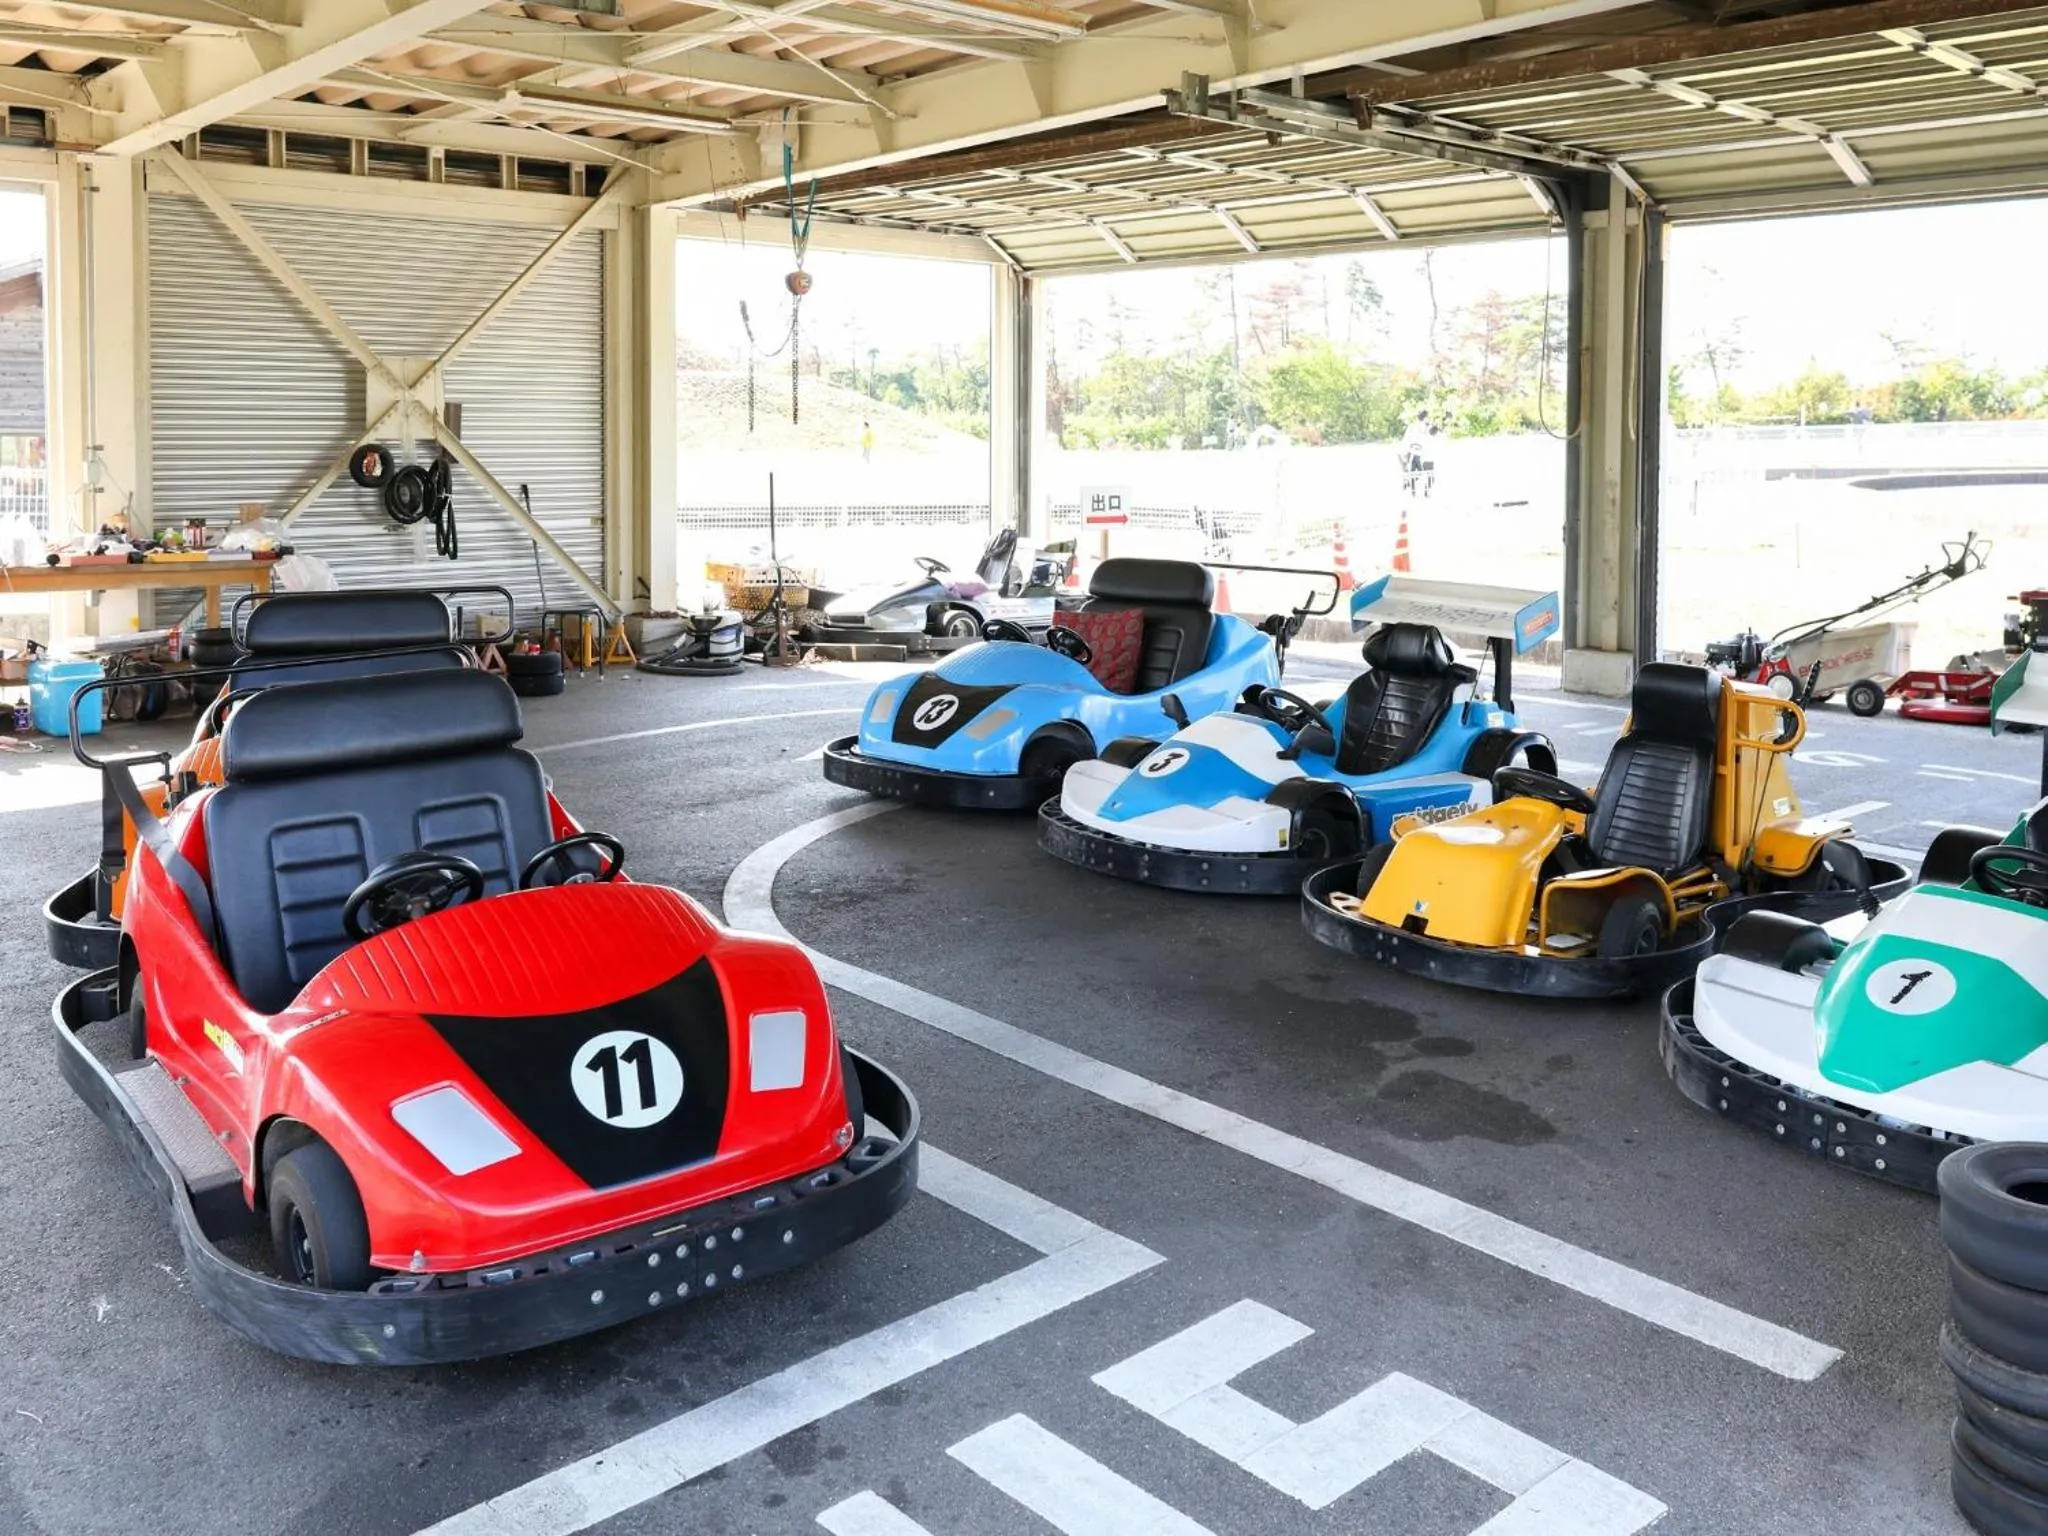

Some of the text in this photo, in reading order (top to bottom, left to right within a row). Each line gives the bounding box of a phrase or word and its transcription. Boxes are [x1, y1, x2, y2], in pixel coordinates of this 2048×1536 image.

[1091, 493, 1121, 512] 出口
[916, 698, 956, 724] 13
[1148, 752, 1184, 773] 3
[1889, 970, 1933, 1004] 1
[585, 1038, 657, 1119] 11
